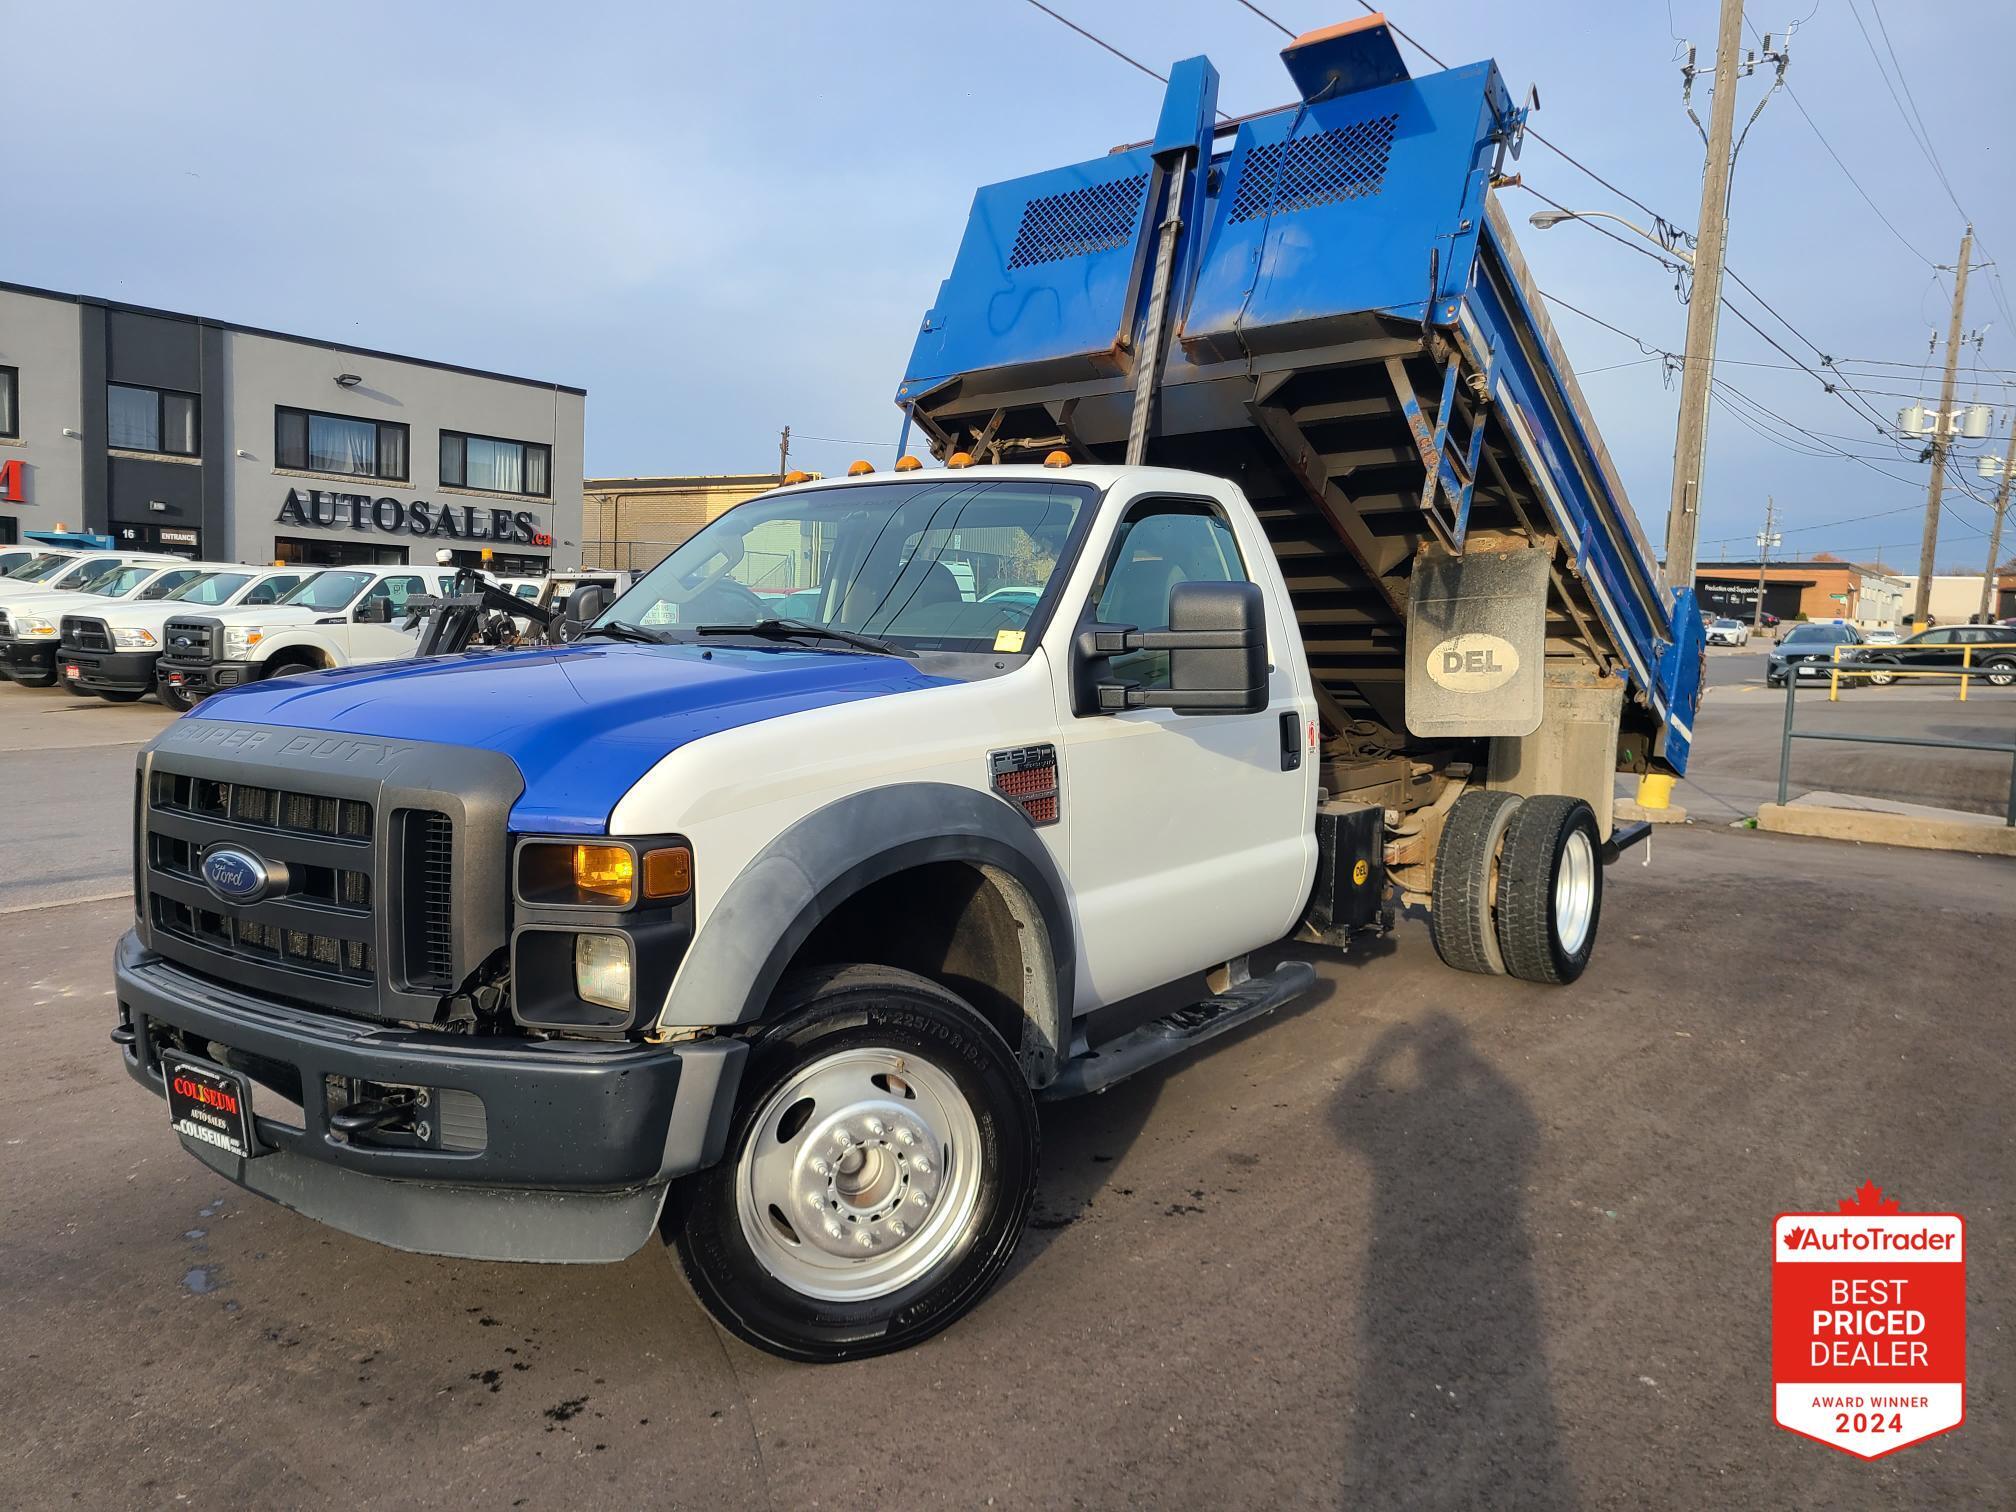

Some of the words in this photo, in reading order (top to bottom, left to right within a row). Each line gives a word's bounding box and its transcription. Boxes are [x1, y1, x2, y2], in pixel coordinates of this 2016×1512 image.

[122, 528, 135, 539] 16
[161, 532, 196, 541] ENTRANCE
[1704, 584, 1726, 592] Production
[1727, 585, 1736, 593] and
[1443, 650, 1502, 674] DEL
[170, 725, 272, 752] SUPER
[277, 735, 416, 766] DUTY
[211, 858, 244, 888] Ford
[174, 1078, 237, 1114] COLISEUM
[191, 1109, 207, 1122] AUTO
[207, 1113, 227, 1130] SALES
